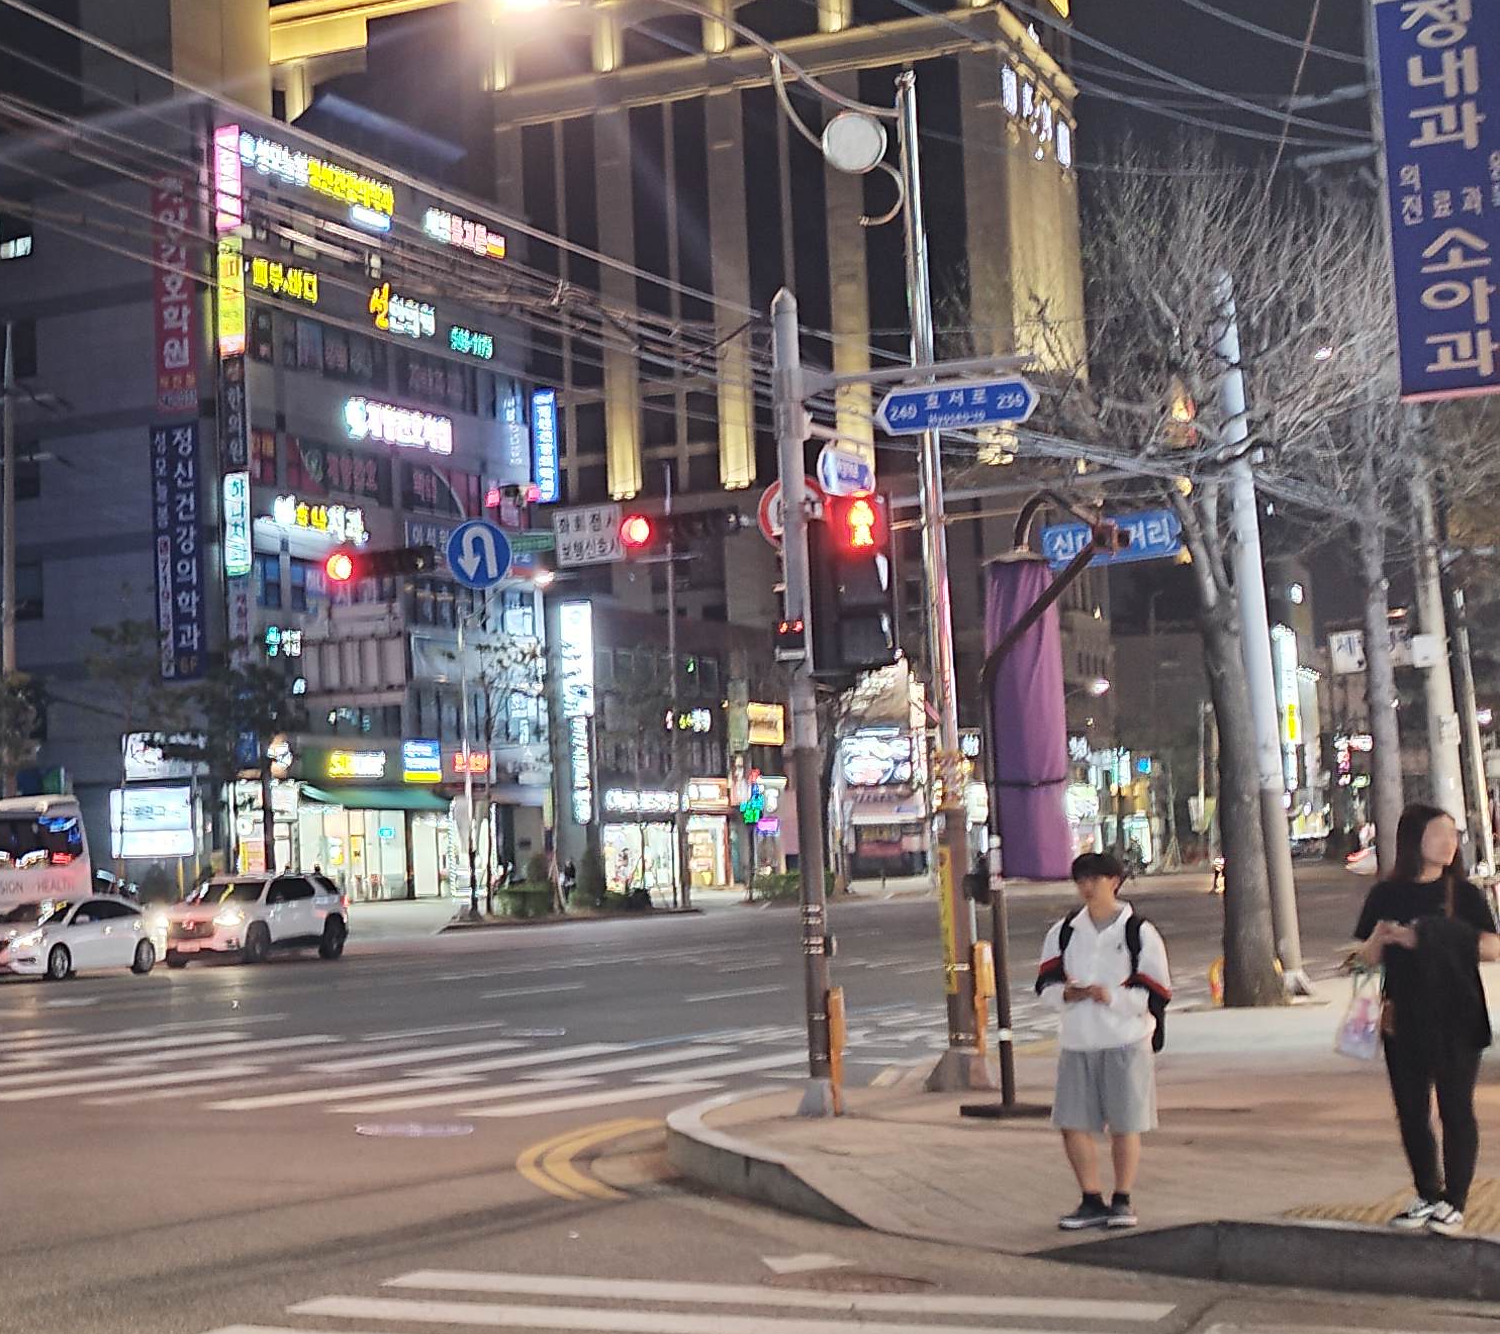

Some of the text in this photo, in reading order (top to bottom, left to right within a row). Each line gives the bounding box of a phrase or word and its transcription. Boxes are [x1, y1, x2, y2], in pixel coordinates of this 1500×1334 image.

[1419, 227, 1500, 378] 소아과
[924, 388, 987, 409] 효서로
[173, 427, 200, 652] 정신건강의학과
